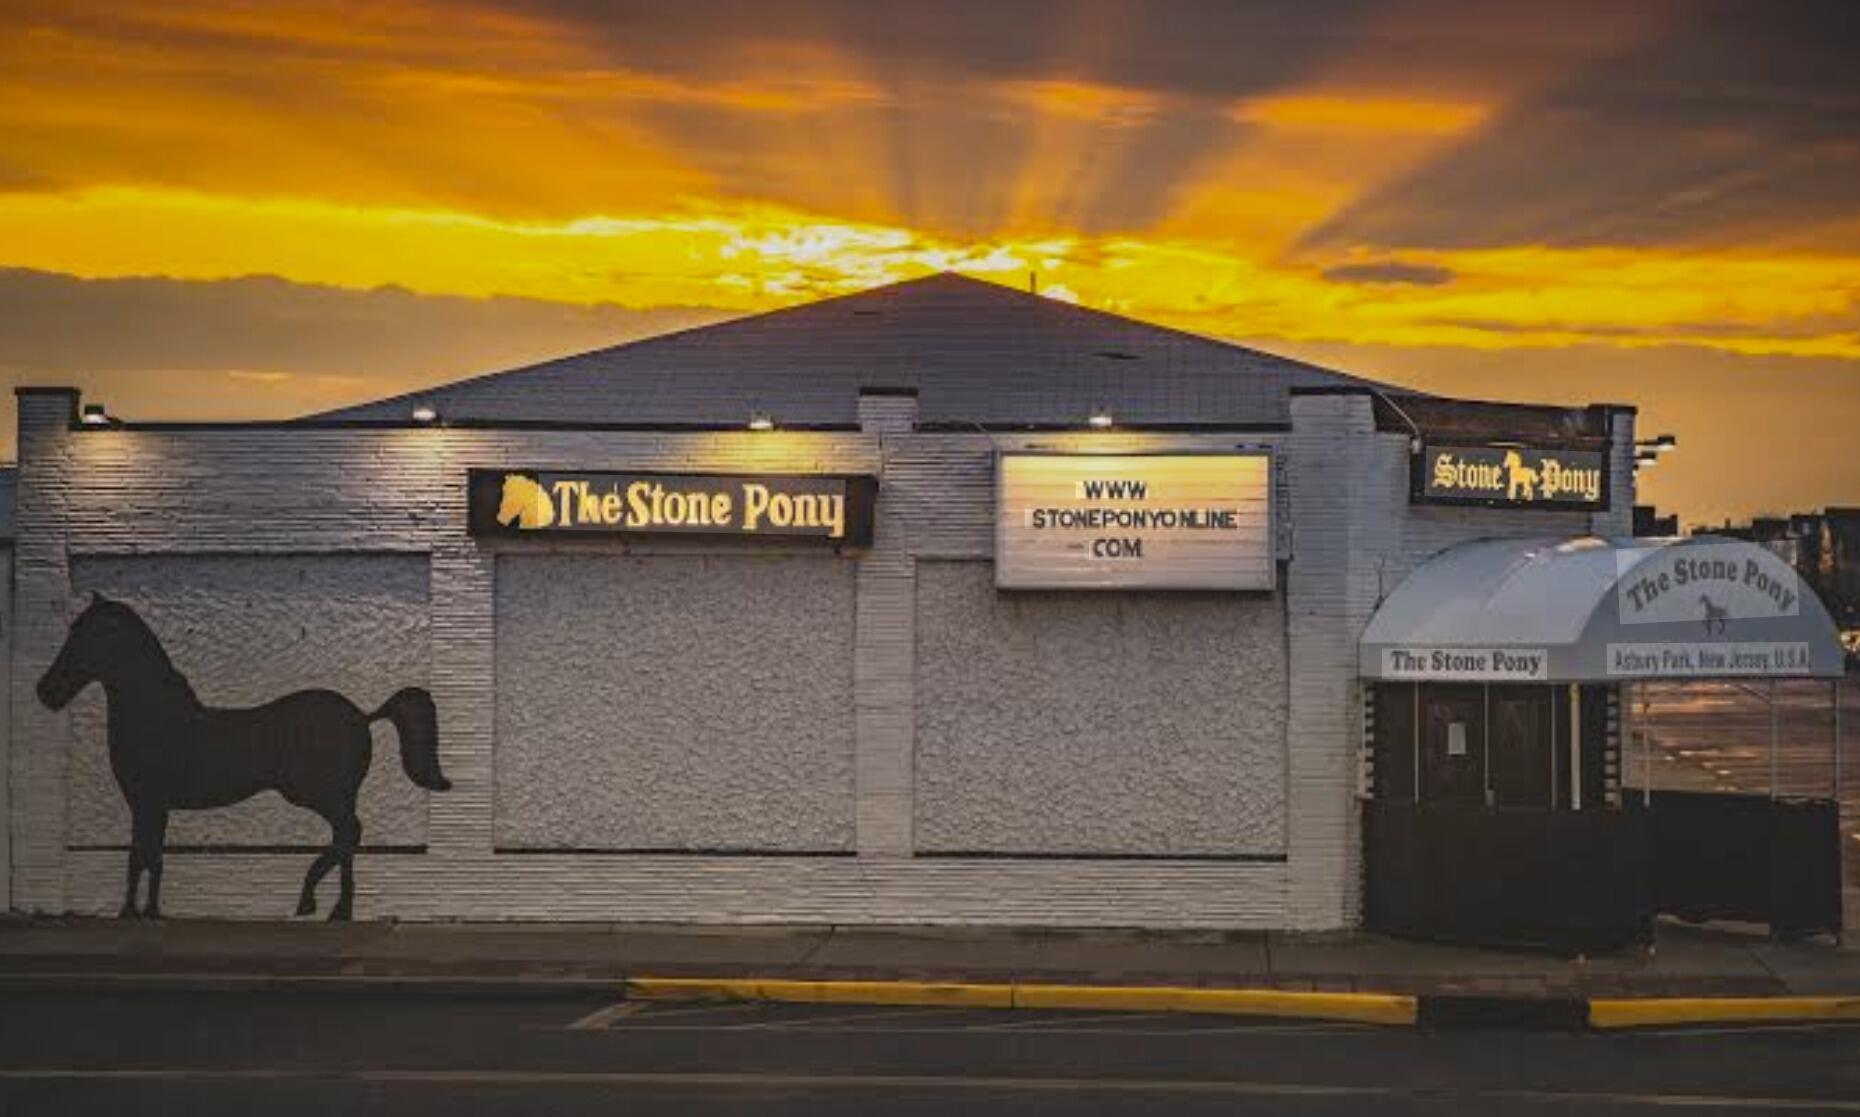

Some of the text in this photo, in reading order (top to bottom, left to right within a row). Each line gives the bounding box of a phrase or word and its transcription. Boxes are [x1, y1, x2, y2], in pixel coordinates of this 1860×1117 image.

[1083, 480, 1148, 500] WWW
[1432, 453, 1600, 500] Stone Pony
[553, 480, 845, 538] The Stone Pony
[1092, 538, 1143, 558] COM
[1627, 558, 1797, 612] The Stone Pony
[1391, 650, 1542, 676] The Stone Pony
